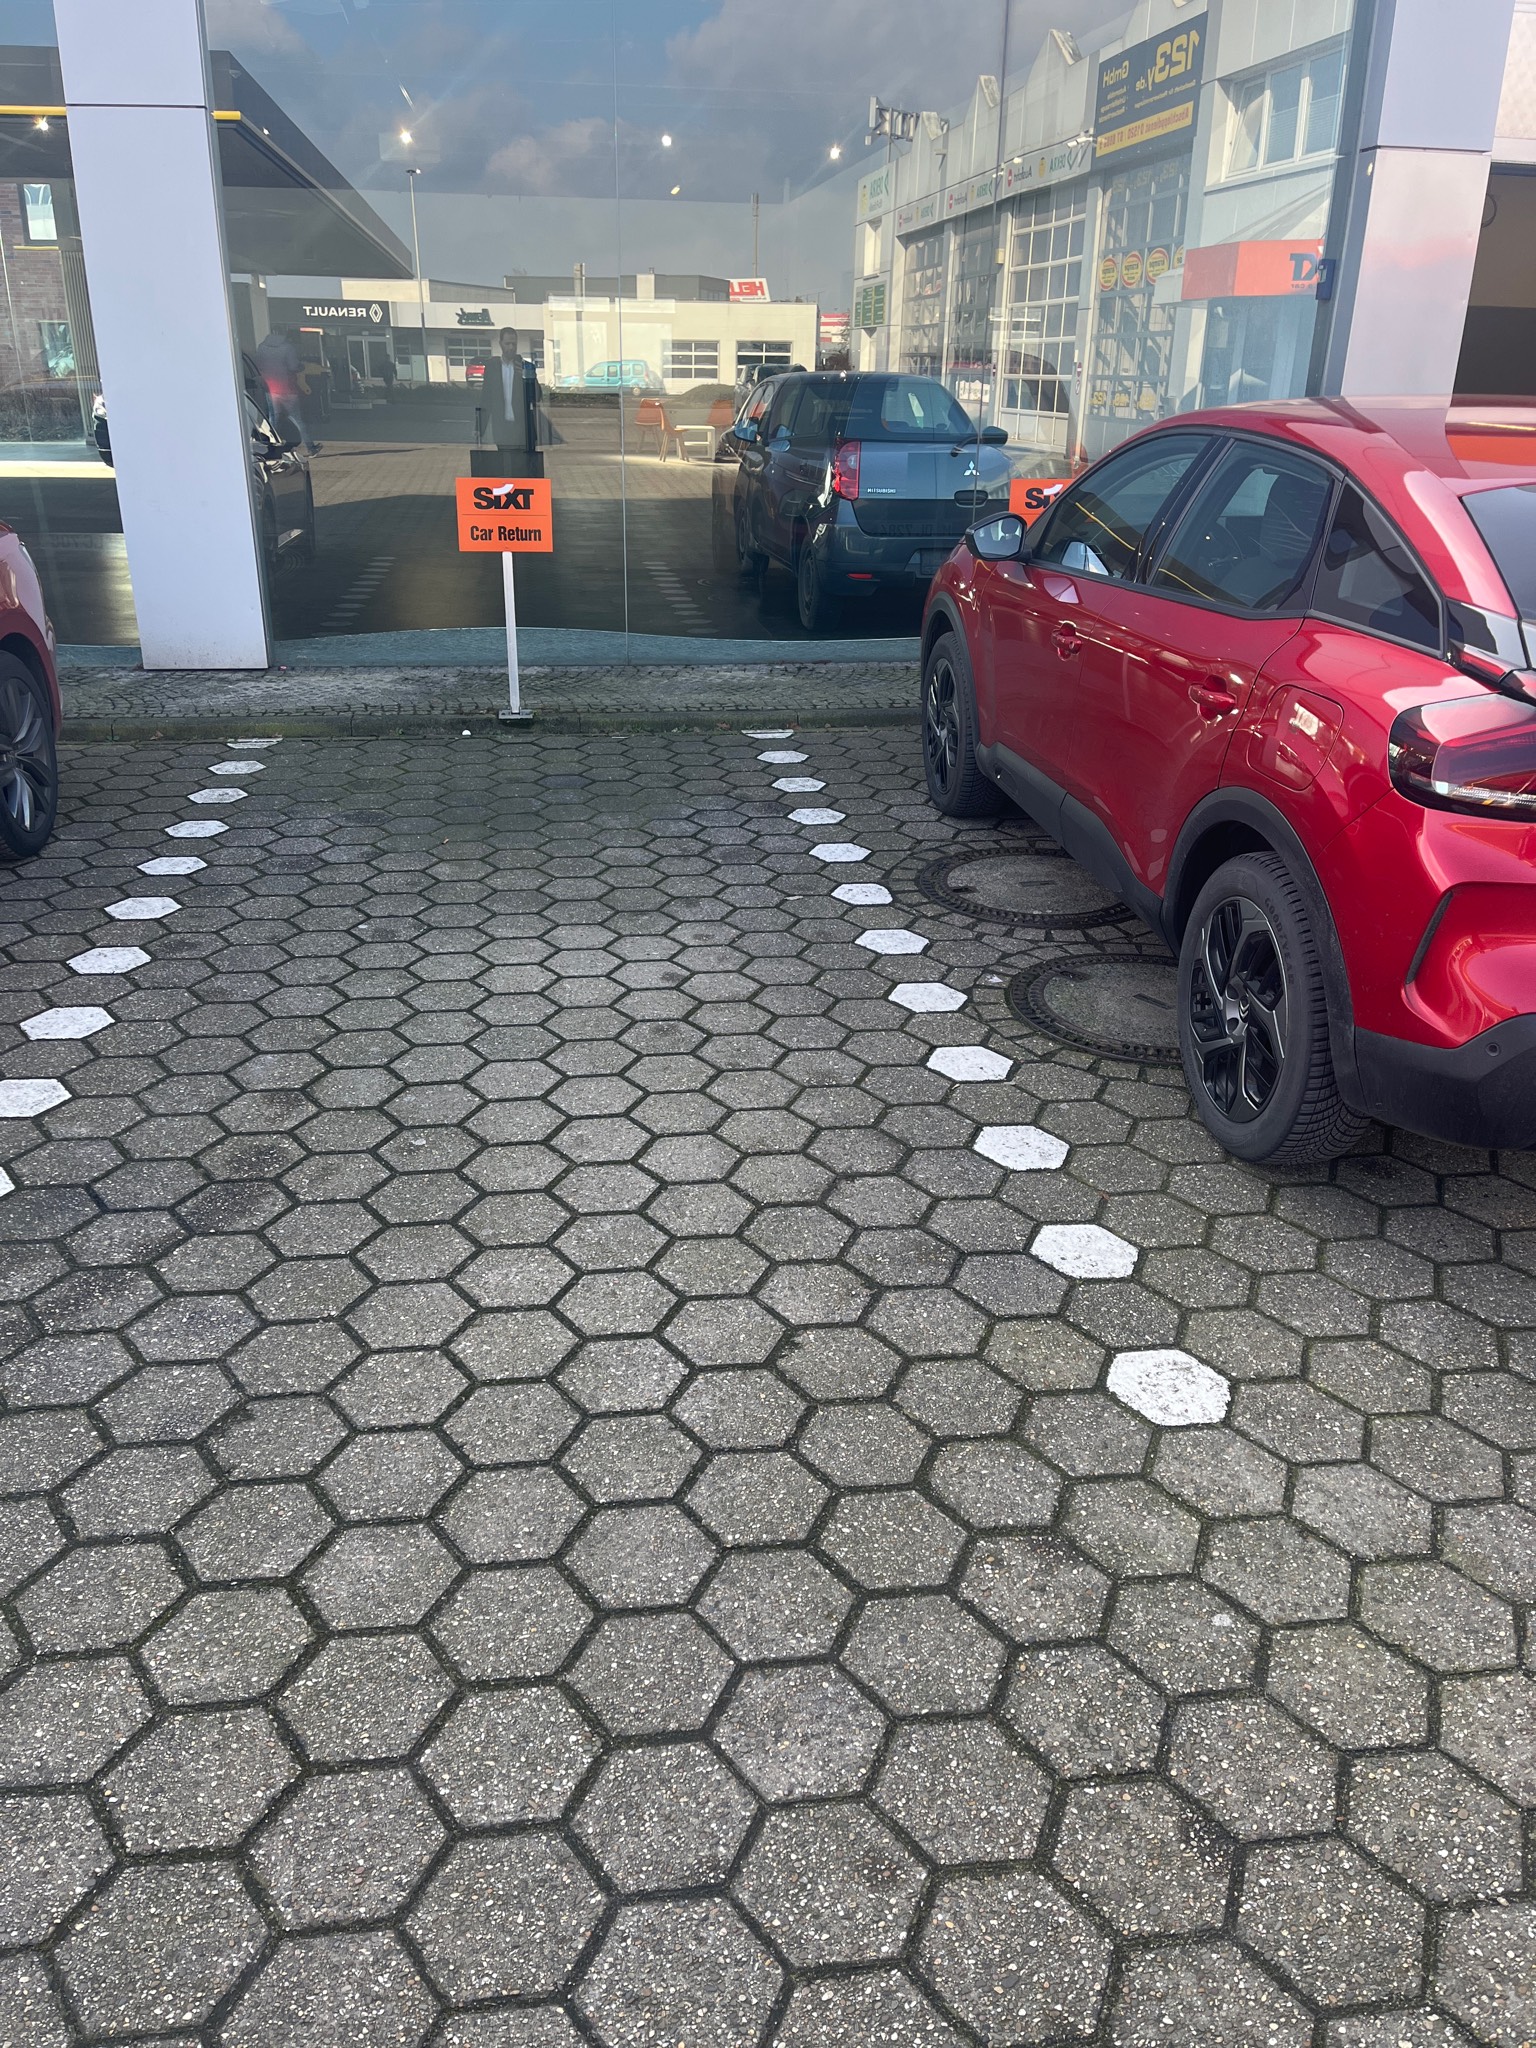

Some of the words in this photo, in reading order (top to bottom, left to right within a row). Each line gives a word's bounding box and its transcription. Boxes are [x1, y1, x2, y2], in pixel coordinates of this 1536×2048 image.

[470, 525, 493, 541] Car
[498, 525, 542, 541] Return
[1265, 897, 1295, 985] GOODYEAR
